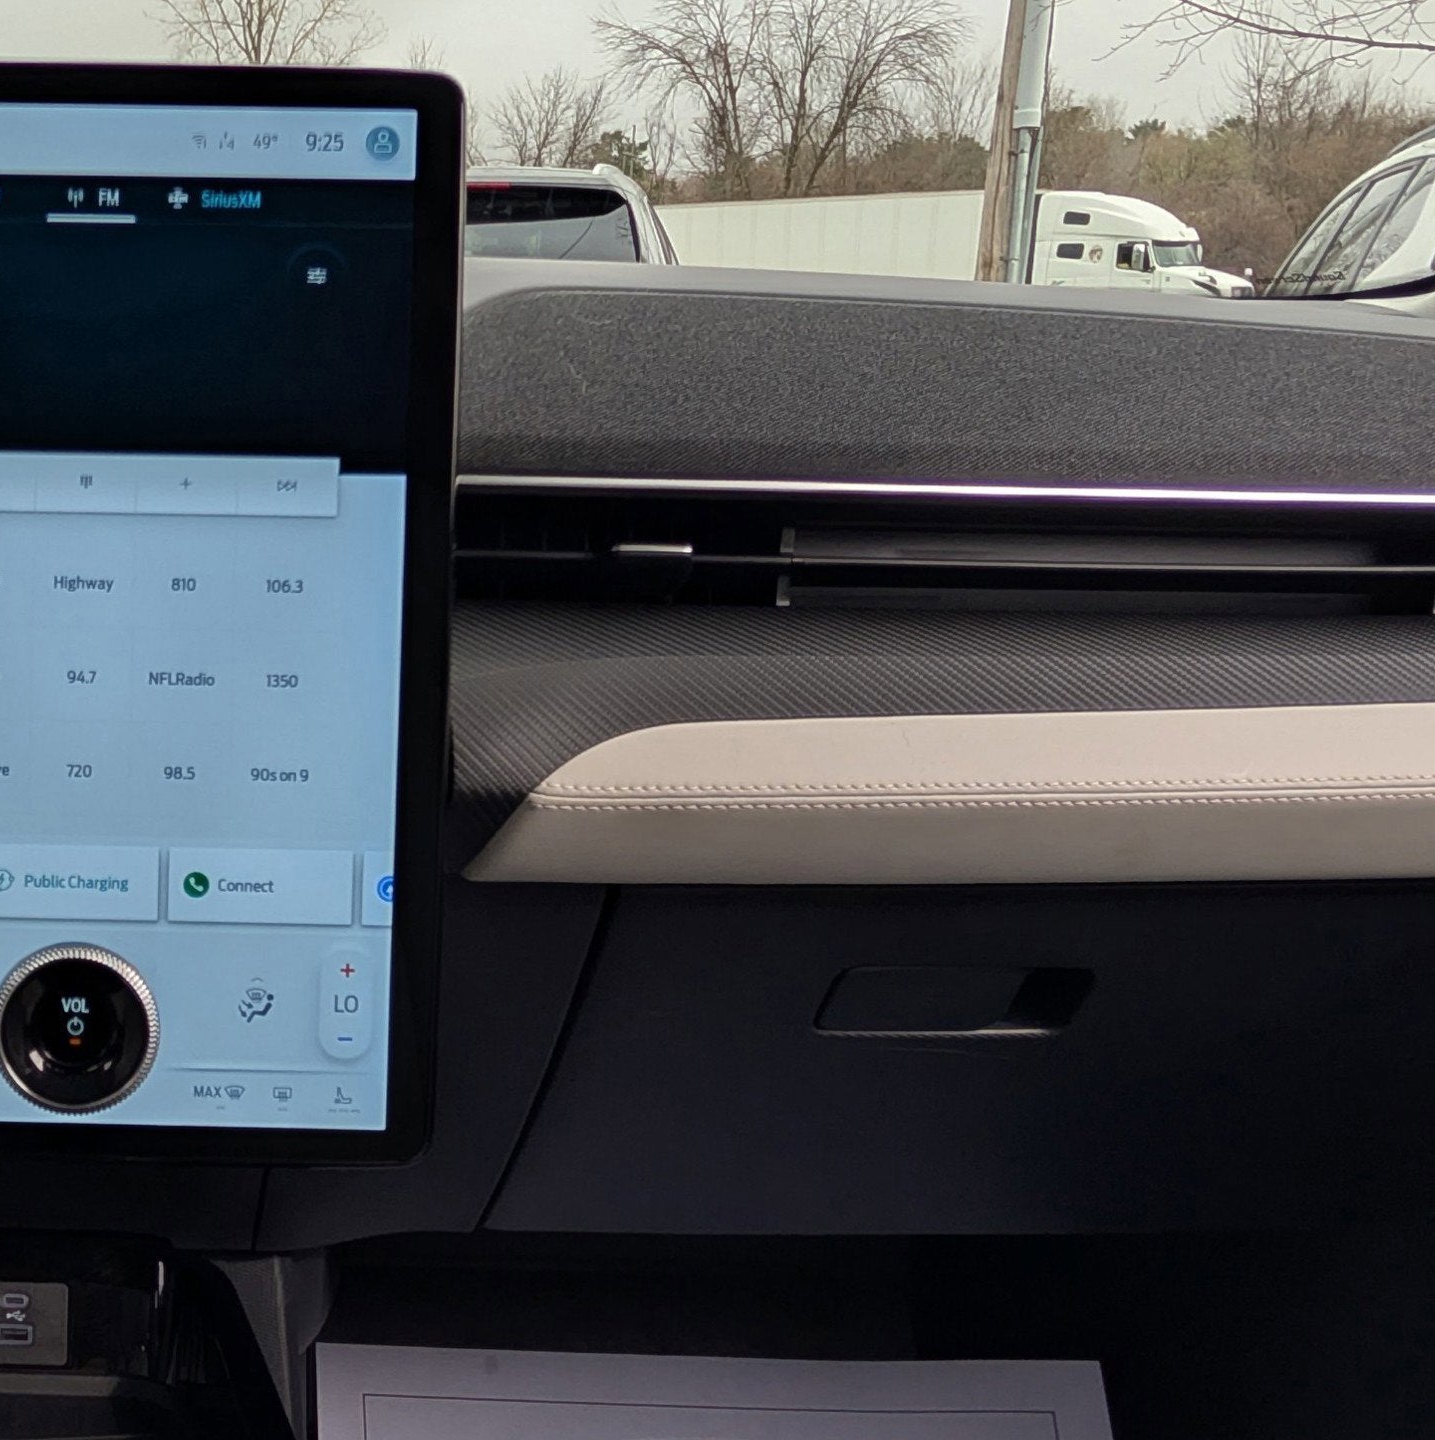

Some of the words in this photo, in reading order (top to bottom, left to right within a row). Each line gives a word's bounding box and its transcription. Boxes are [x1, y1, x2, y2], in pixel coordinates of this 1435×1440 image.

[306, 132, 345, 154] 9:25
[98, 189, 120, 207] FM
[201, 190, 261, 209] SiriusXM
[53, 576, 114, 593] Highway
[171, 578, 197, 592] 810
[265, 579, 304, 594] 106.3
[67, 671, 97, 685] 94.7
[265, 674, 299, 688] 1350
[66, 764, 93, 778] 720
[163, 766, 196, 780] 98.5
[250, 768, 278, 782] 90s
[279, 770, 297, 783] on
[300, 769, 309, 783] 9
[24, 874, 66, 889] Public
[68, 876, 129, 892] Charging
[217, 879, 274, 894] Connect
[61, 997, 89, 1014] VOL
[334, 994, 359, 1013] LO
[193, 1085, 222, 1099] MAX
